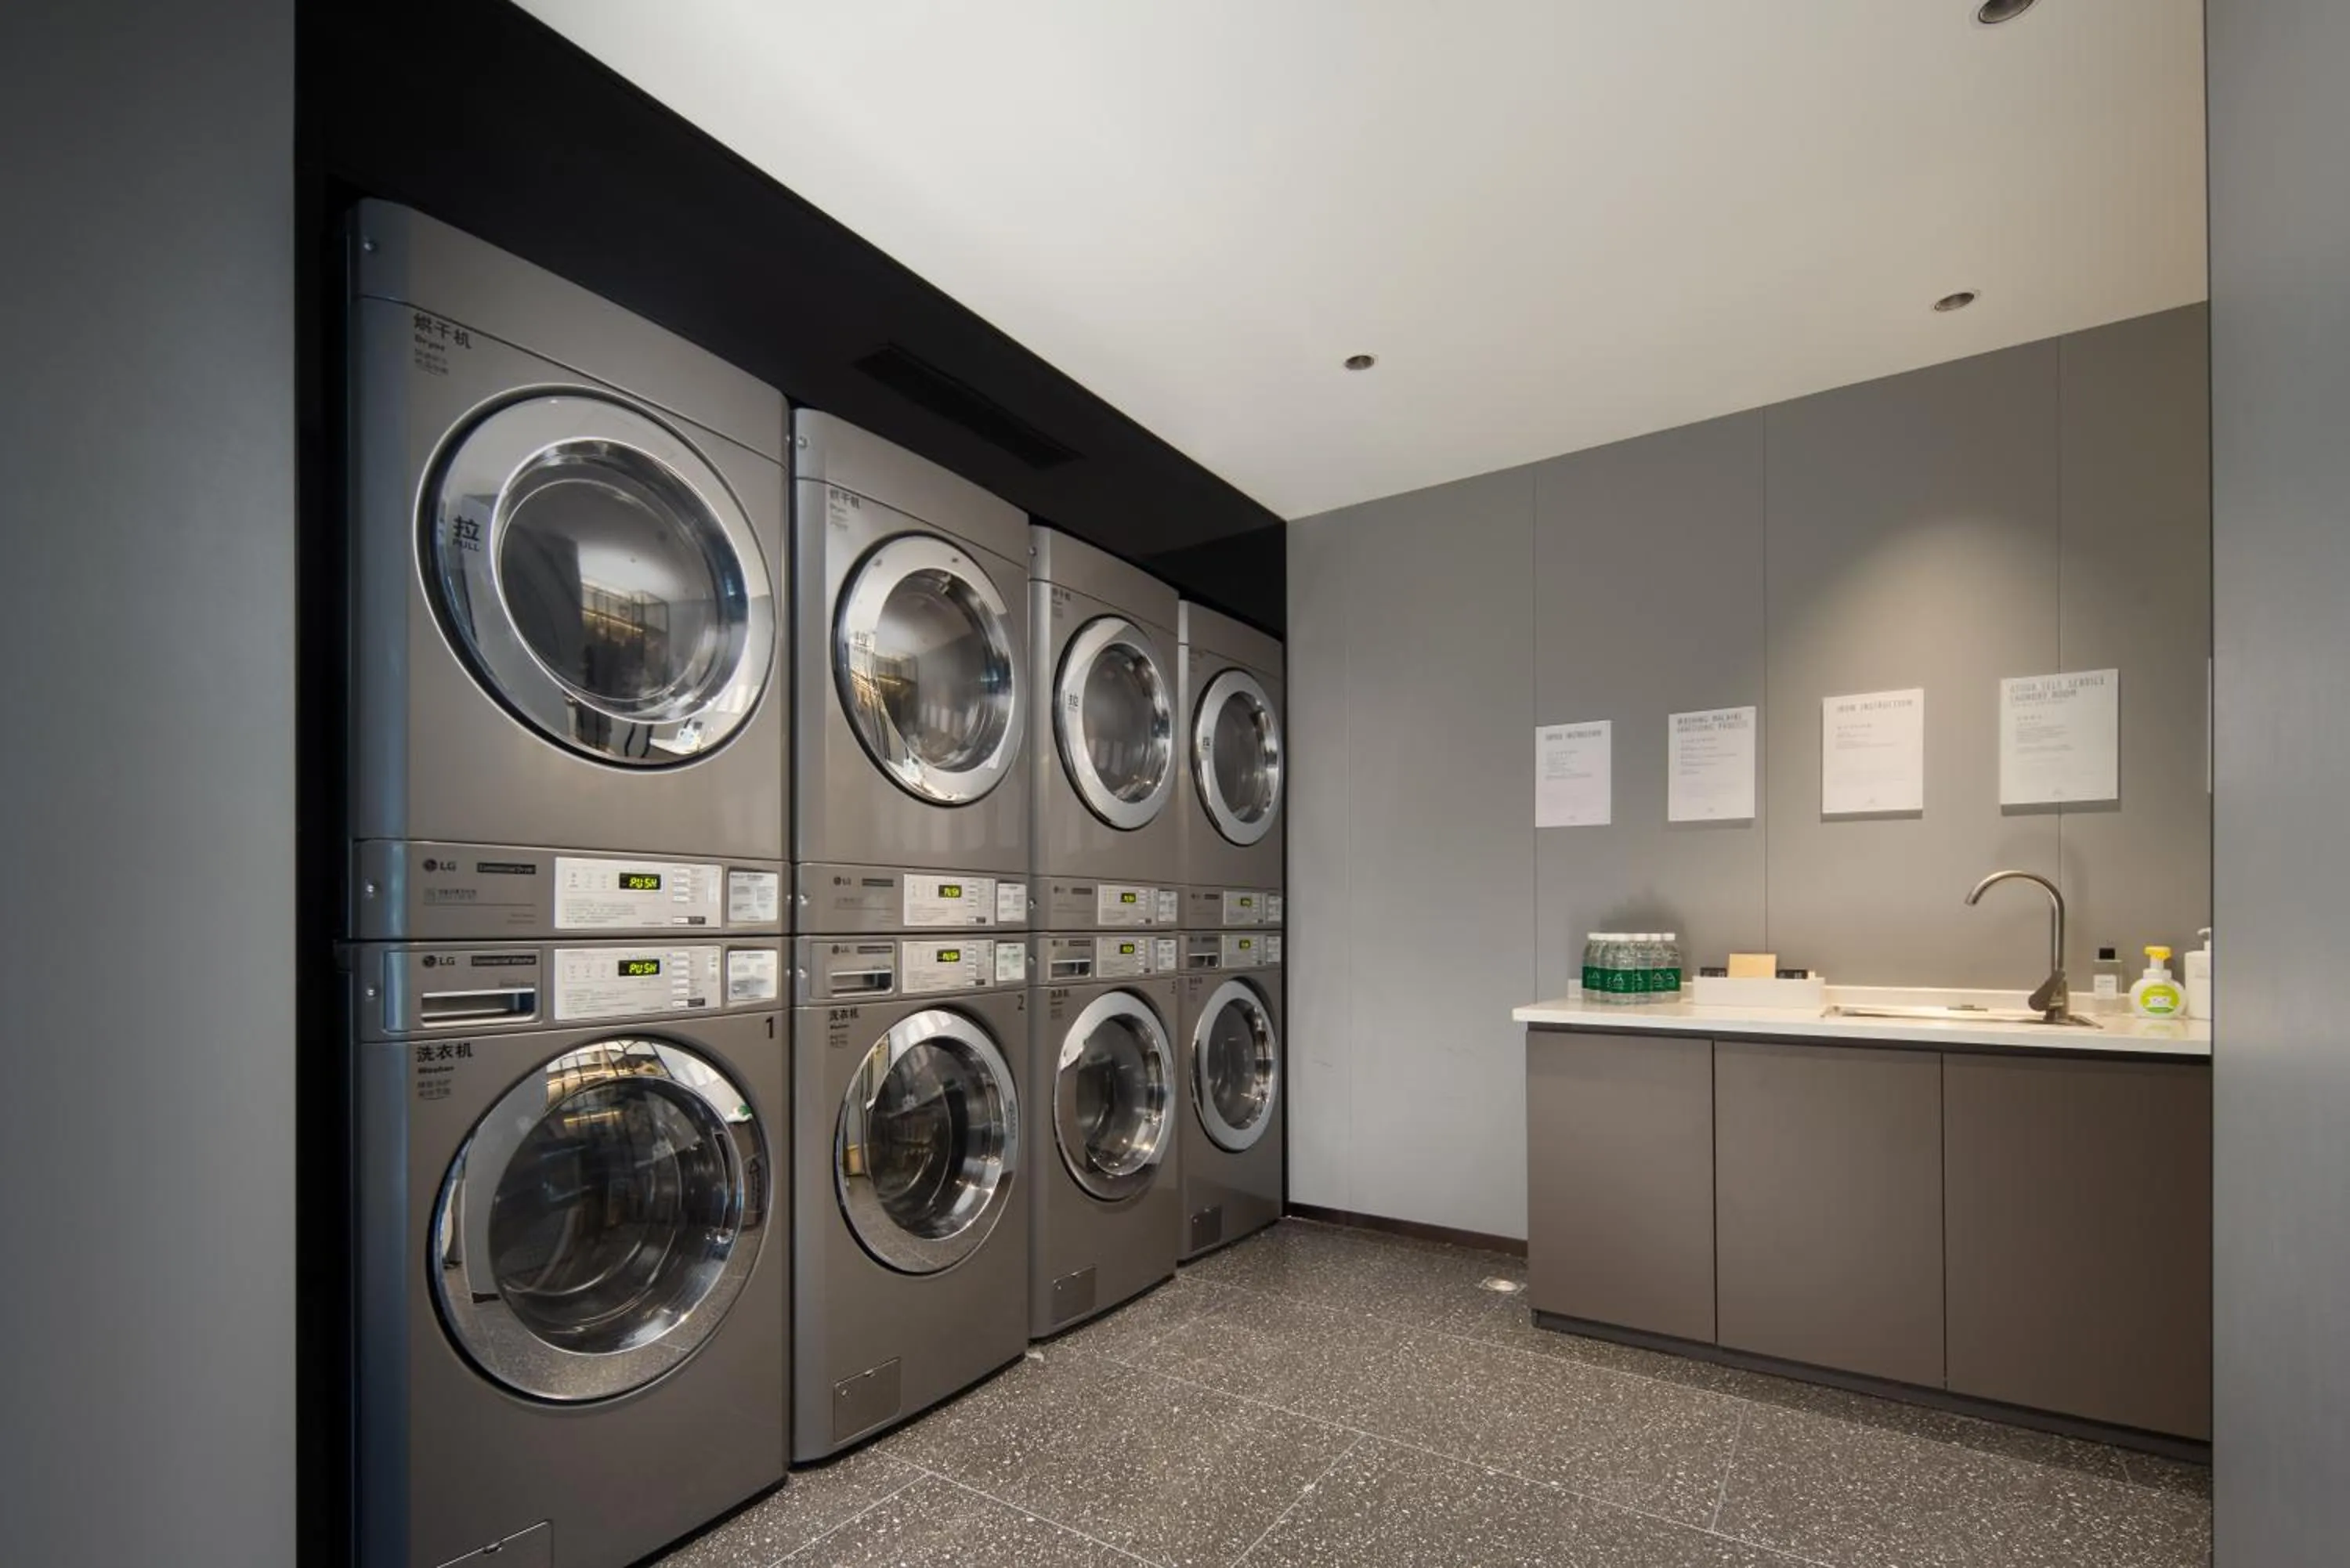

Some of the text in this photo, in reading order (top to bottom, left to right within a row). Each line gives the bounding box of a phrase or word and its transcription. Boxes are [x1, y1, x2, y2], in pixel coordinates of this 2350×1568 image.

[453, 514, 480, 541] 拉
[453, 538, 479, 551] PULL
[439, 862, 456, 872] LG
[629, 877, 657, 889] PUSH
[629, 963, 656, 974] PUSH
[1018, 995, 1025, 1010] 2
[765, 1017, 775, 1039] 1
[417, 1043, 473, 1062] 洗衣机
